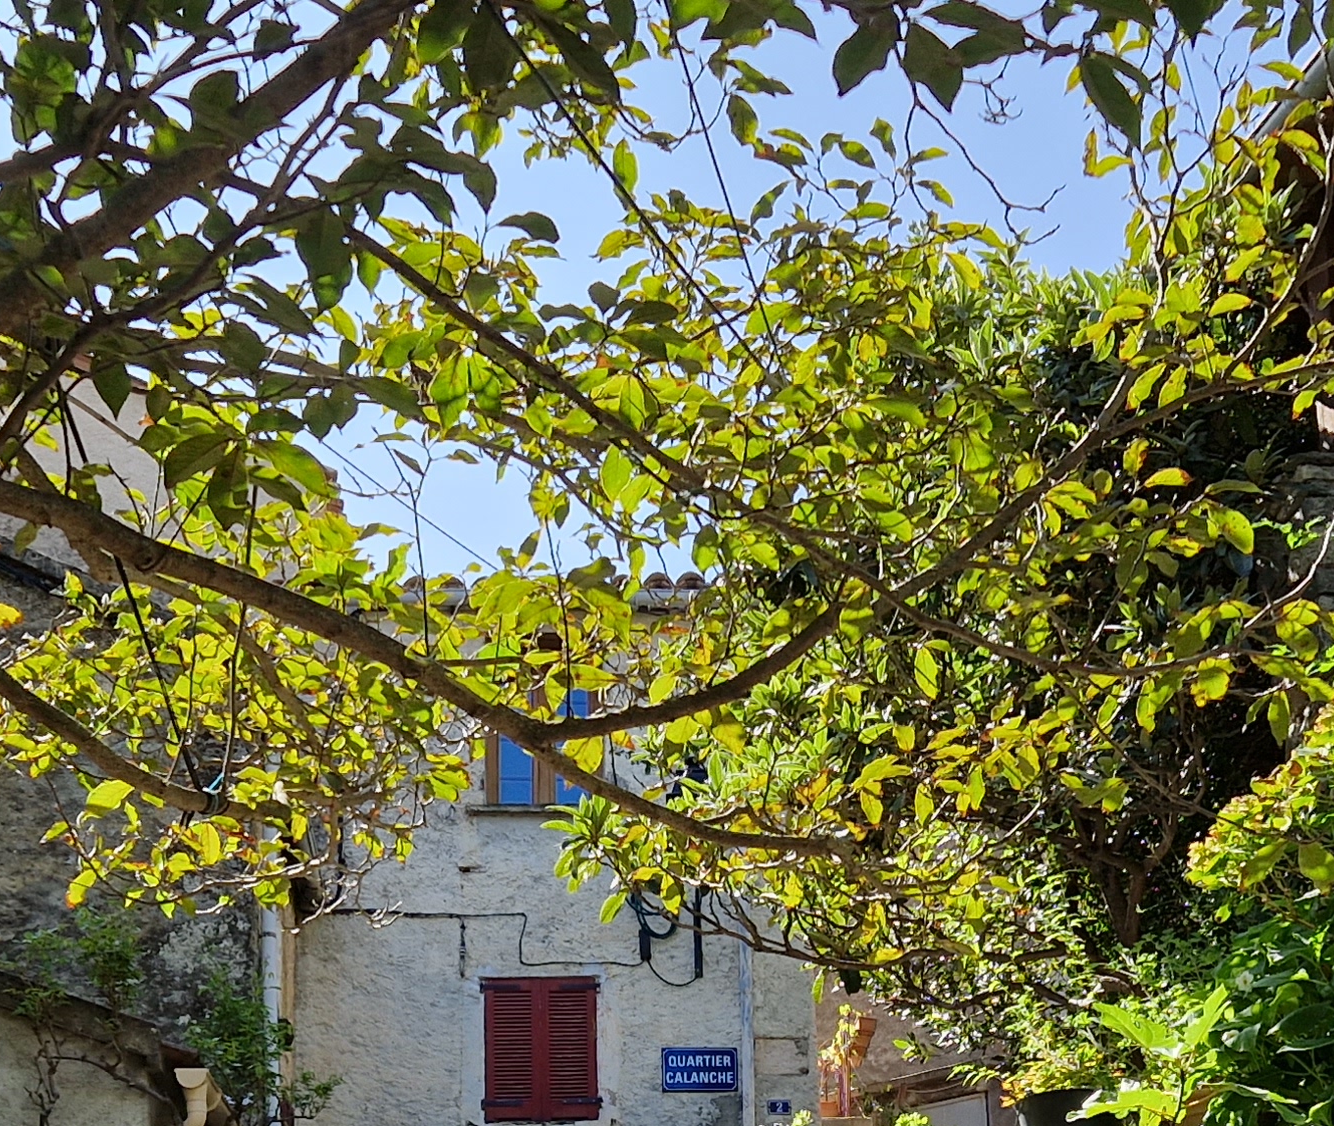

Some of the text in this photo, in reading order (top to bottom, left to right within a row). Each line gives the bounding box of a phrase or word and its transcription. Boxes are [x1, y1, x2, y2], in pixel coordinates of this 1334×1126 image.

[668, 1055, 731, 1067] QUARTIER
[667, 1072, 734, 1084] CALANCHE
[776, 1102, 783, 1112] 2
